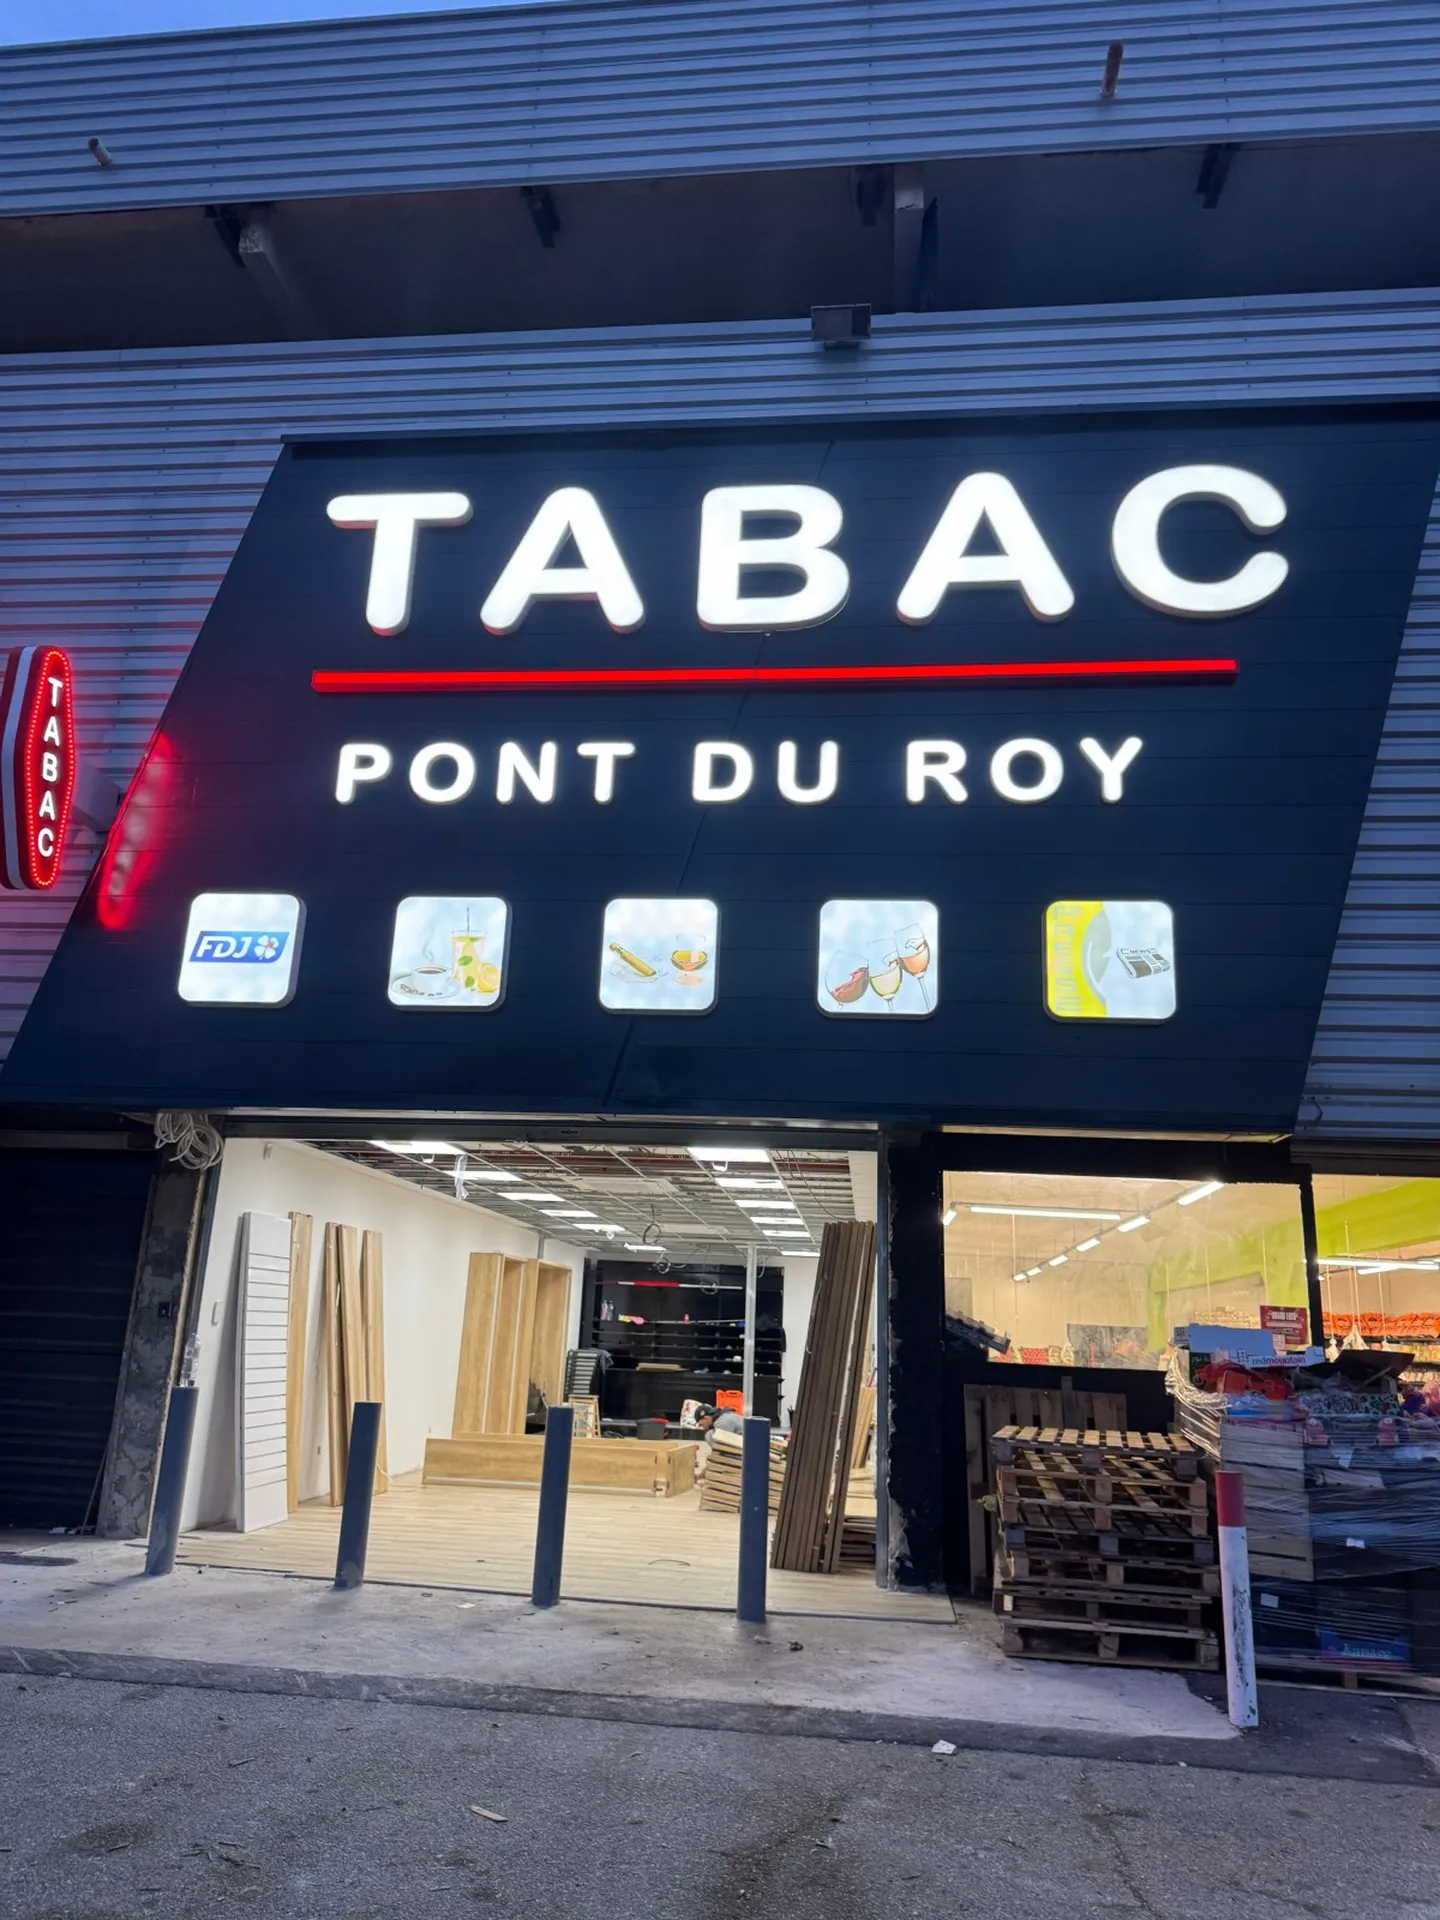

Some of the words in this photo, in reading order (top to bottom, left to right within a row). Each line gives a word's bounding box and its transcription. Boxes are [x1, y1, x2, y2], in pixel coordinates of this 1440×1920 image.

[325, 464, 1290, 631] TABAC
[38, 676, 63, 858] TABAC
[334, 740, 637, 805] PONT
[691, 740, 839, 805] DU
[905, 736, 1144, 804] ROY
[196, 935, 253, 958] FDJ
[1251, 1355, 1306, 1366] redmountain
